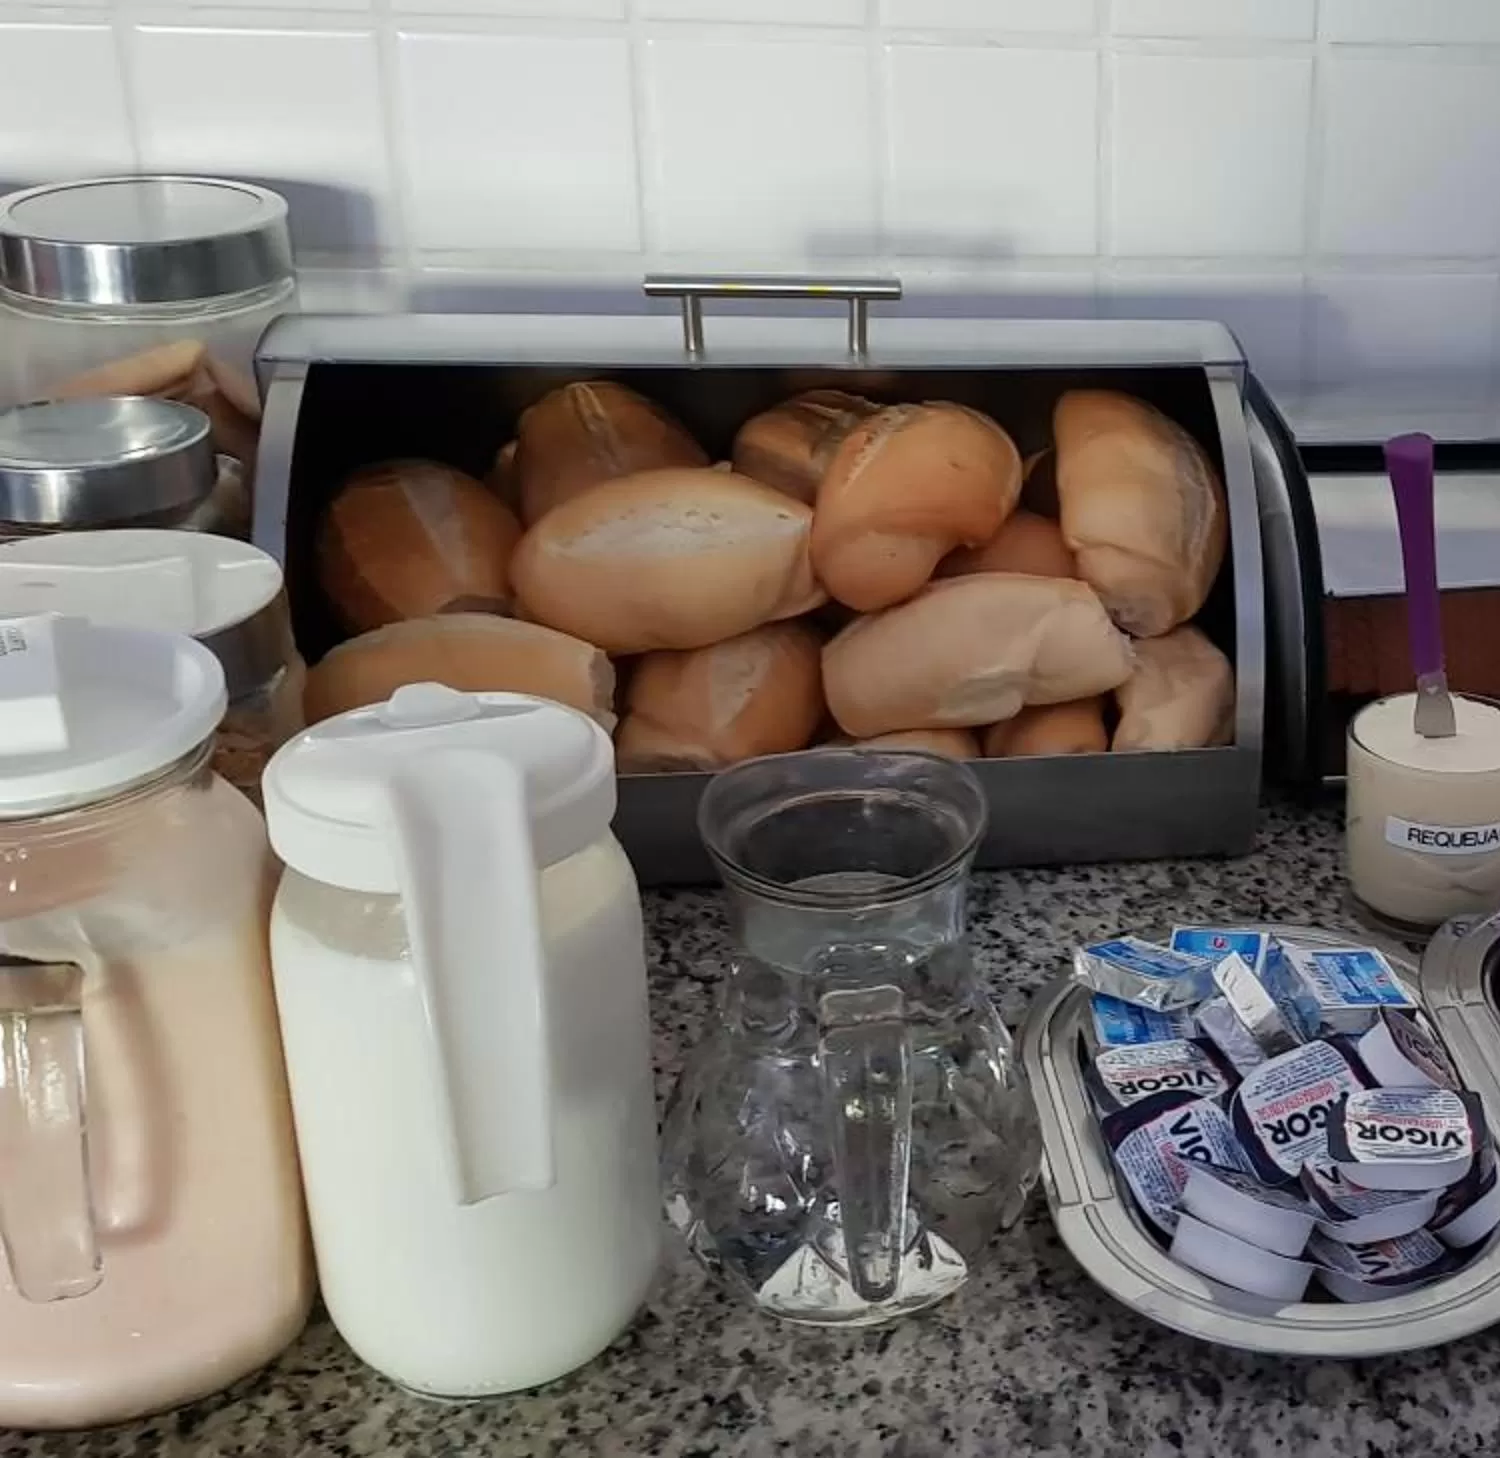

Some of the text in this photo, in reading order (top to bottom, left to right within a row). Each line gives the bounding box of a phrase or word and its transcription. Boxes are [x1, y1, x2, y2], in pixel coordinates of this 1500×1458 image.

[1111, 1069, 1217, 1095] VIGOR
[1170, 1111, 1212, 1163] VIG
[1262, 1090, 1348, 1145] GOR
[1354, 1121, 1464, 1147] VIGOR
